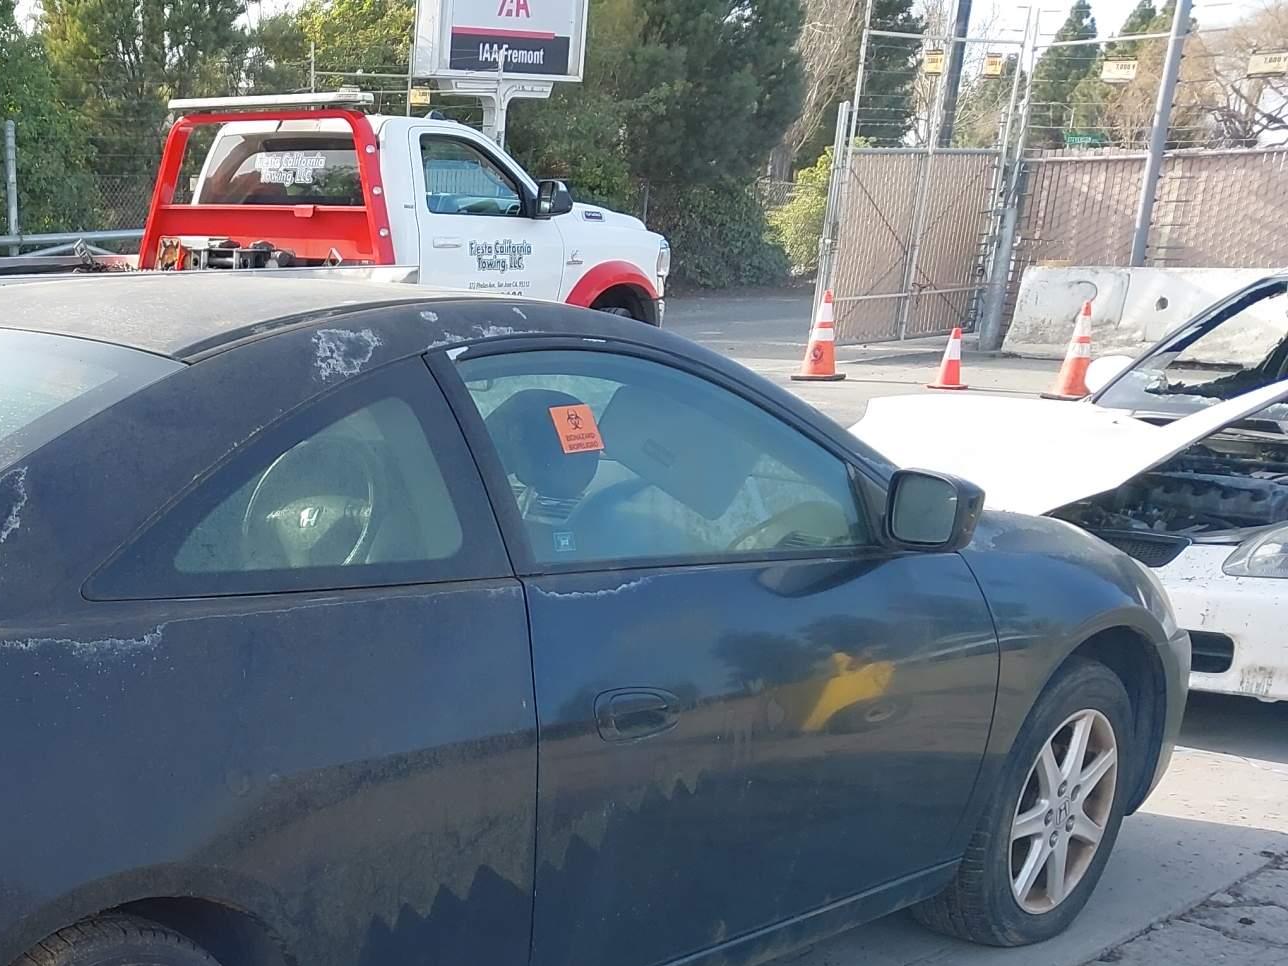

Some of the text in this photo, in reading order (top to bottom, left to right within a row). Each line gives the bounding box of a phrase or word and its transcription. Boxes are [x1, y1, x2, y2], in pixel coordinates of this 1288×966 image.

[478, 42, 545, 65] IAA Fremont
[282, 151, 326, 168] California
[469, 239, 532, 256] Fiesta California
